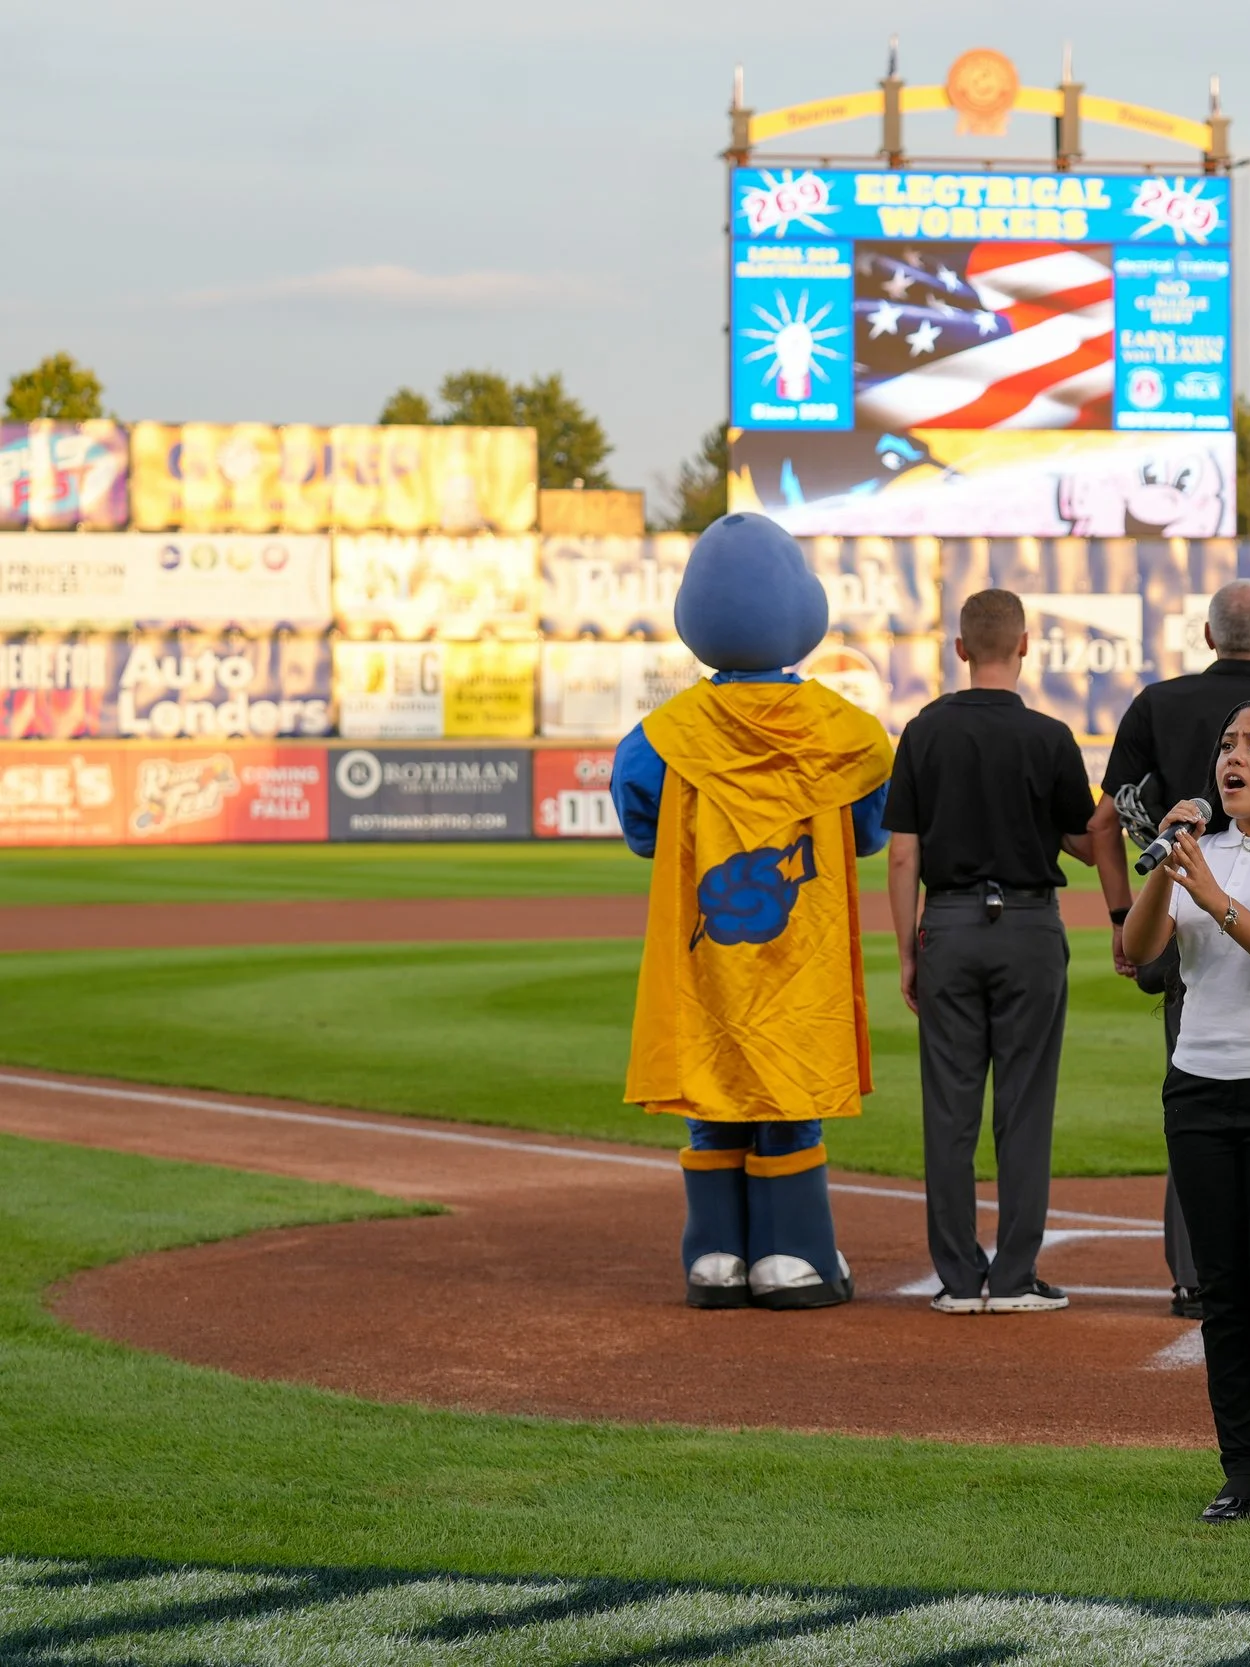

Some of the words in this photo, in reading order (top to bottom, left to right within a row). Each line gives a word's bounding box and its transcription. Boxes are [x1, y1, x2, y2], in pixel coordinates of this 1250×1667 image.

[854, 174, 1111, 209] ELECTRICAL
[1135, 183, 1216, 233] 269
[877, 206, 1088, 239] WORKERS
[119, 644, 254, 689] Auto
[117, 688, 330, 735] Lenders
[242, 766, 319, 784] COMING
[384, 761, 519, 783] ROTHMAN
[259, 785, 304, 800] THIS
[250, 800, 311, 820] FALL!
